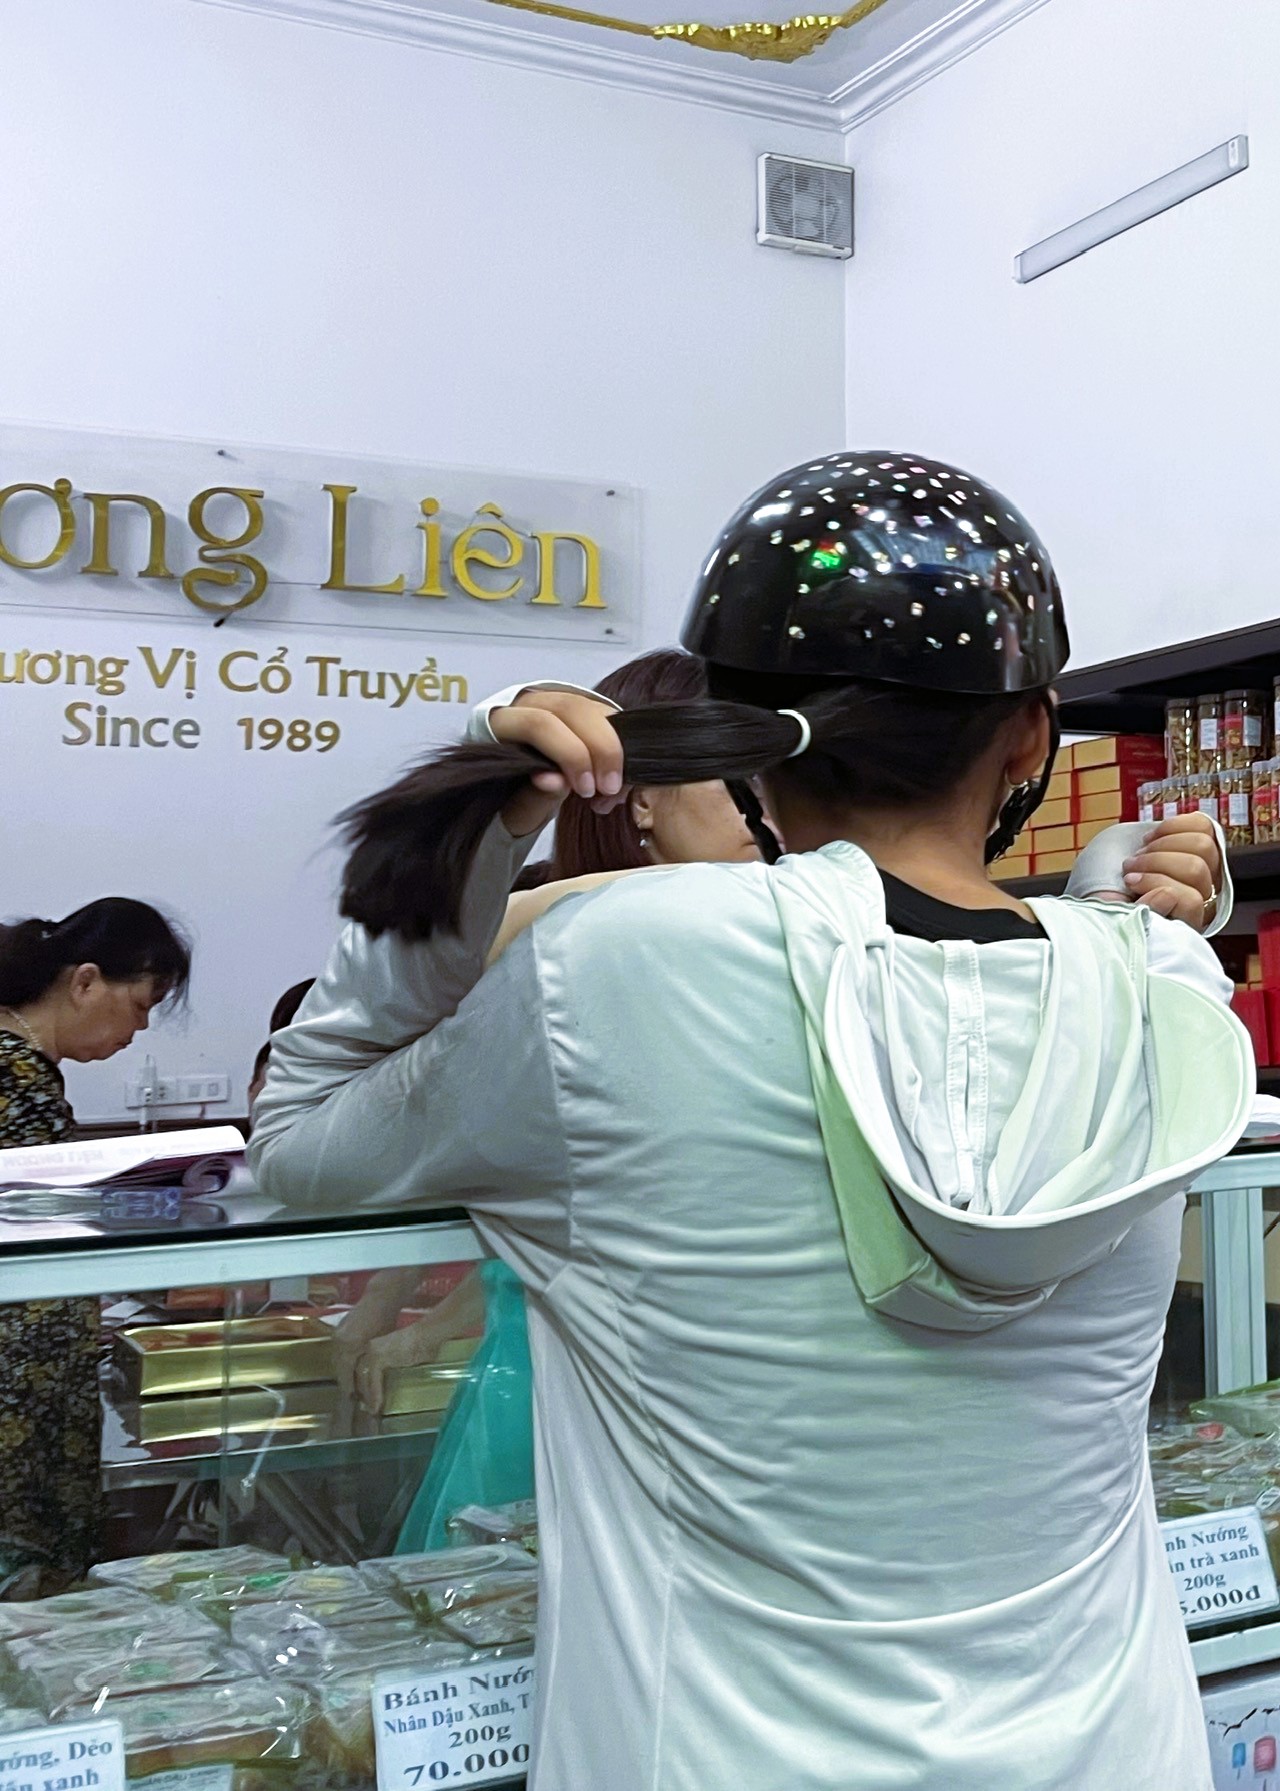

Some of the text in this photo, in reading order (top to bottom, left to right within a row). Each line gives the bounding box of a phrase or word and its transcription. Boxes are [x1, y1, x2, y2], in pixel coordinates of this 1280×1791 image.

[320, 484, 608, 609] Liên
[137, 646, 197, 699] Vị
[219, 646, 292, 694] Cổ
[62, 701, 341, 752] Since 1989
[1165, 1525, 1249, 1552] nh Nướng
[1190, 1552, 1215, 1570] trà
[1220, 1544, 1260, 1563] xanh
[1184, 1573, 1227, 1592] 200g
[384, 1682, 458, 1711] Bánh
[384, 1714, 427, 1736] Nhân
[468, 1698, 515, 1720] Xanh,
[68, 1738, 113, 1760] Dẻo
[449, 1724, 512, 1749] 200g
[44, 1768, 99, 1791] xanh
